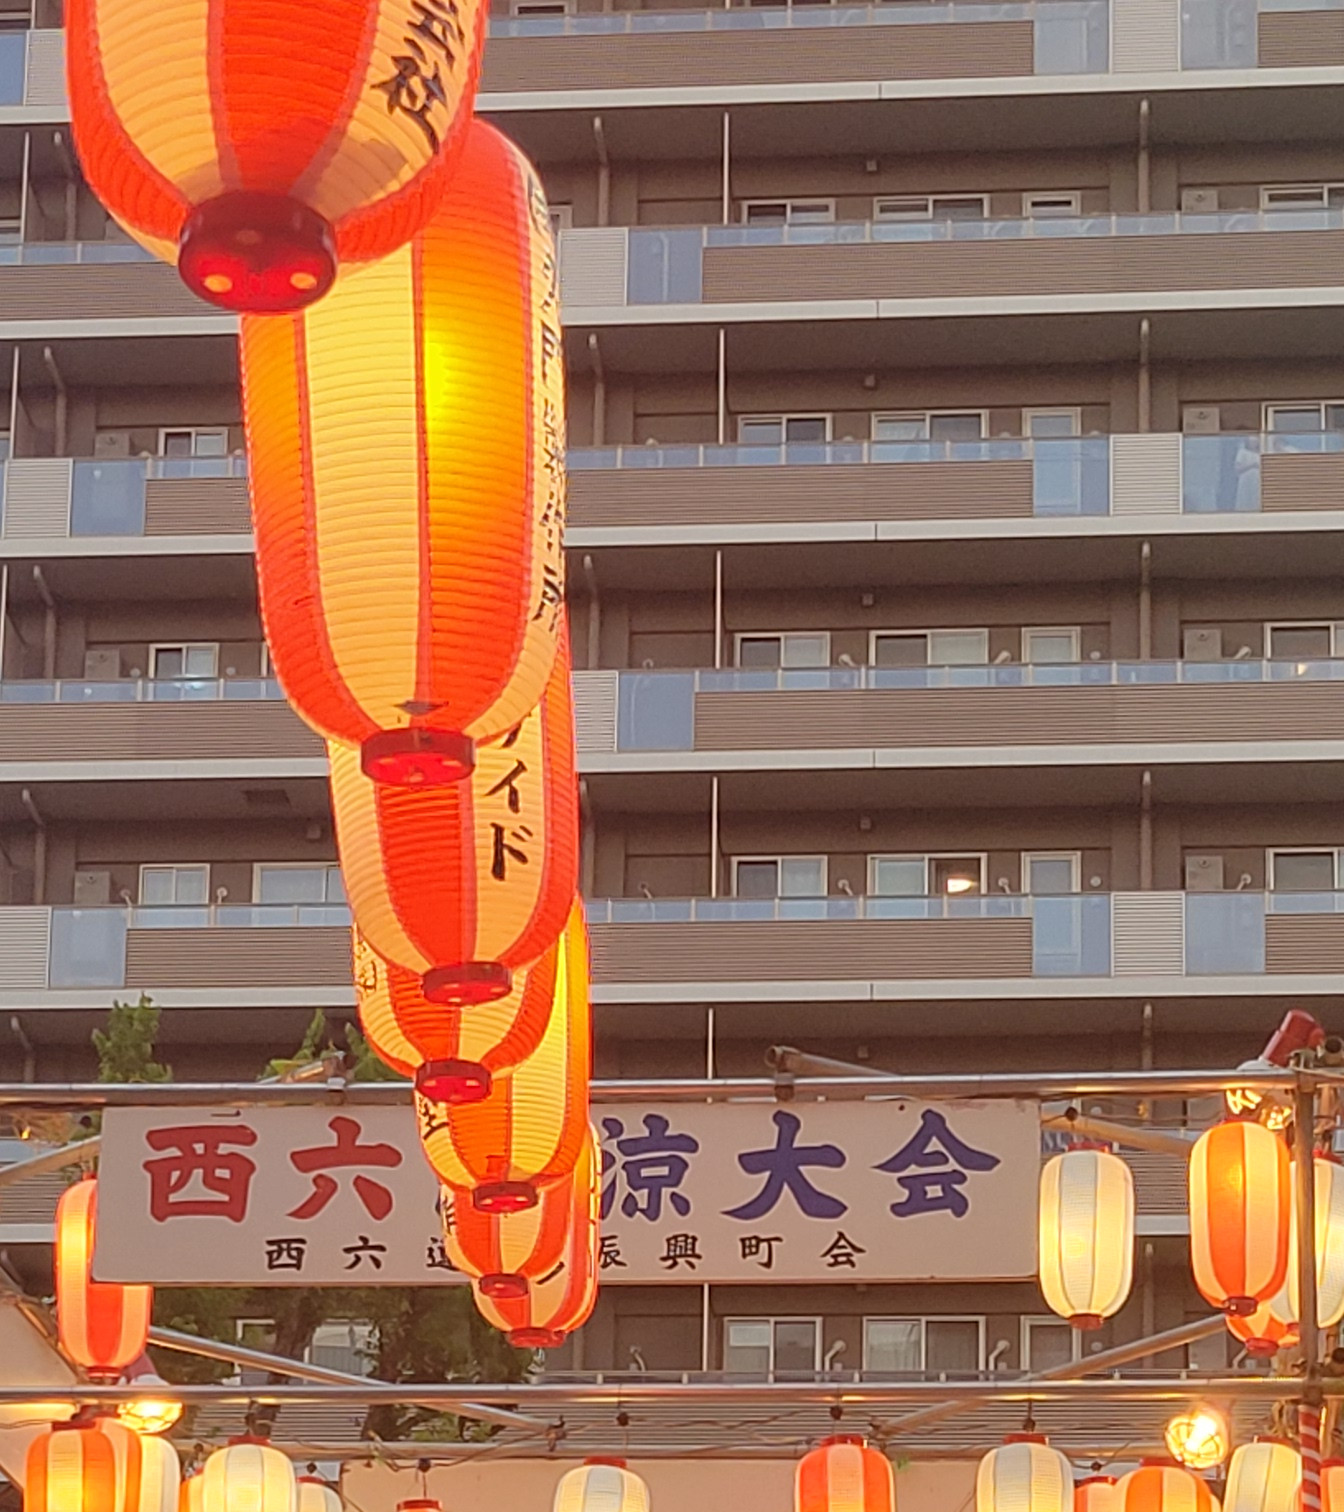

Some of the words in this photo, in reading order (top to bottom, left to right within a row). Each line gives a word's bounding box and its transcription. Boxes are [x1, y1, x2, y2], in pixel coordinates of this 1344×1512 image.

[483, 711, 534, 882] イド
[142, 1109, 1002, 1224] 西六涼大会
